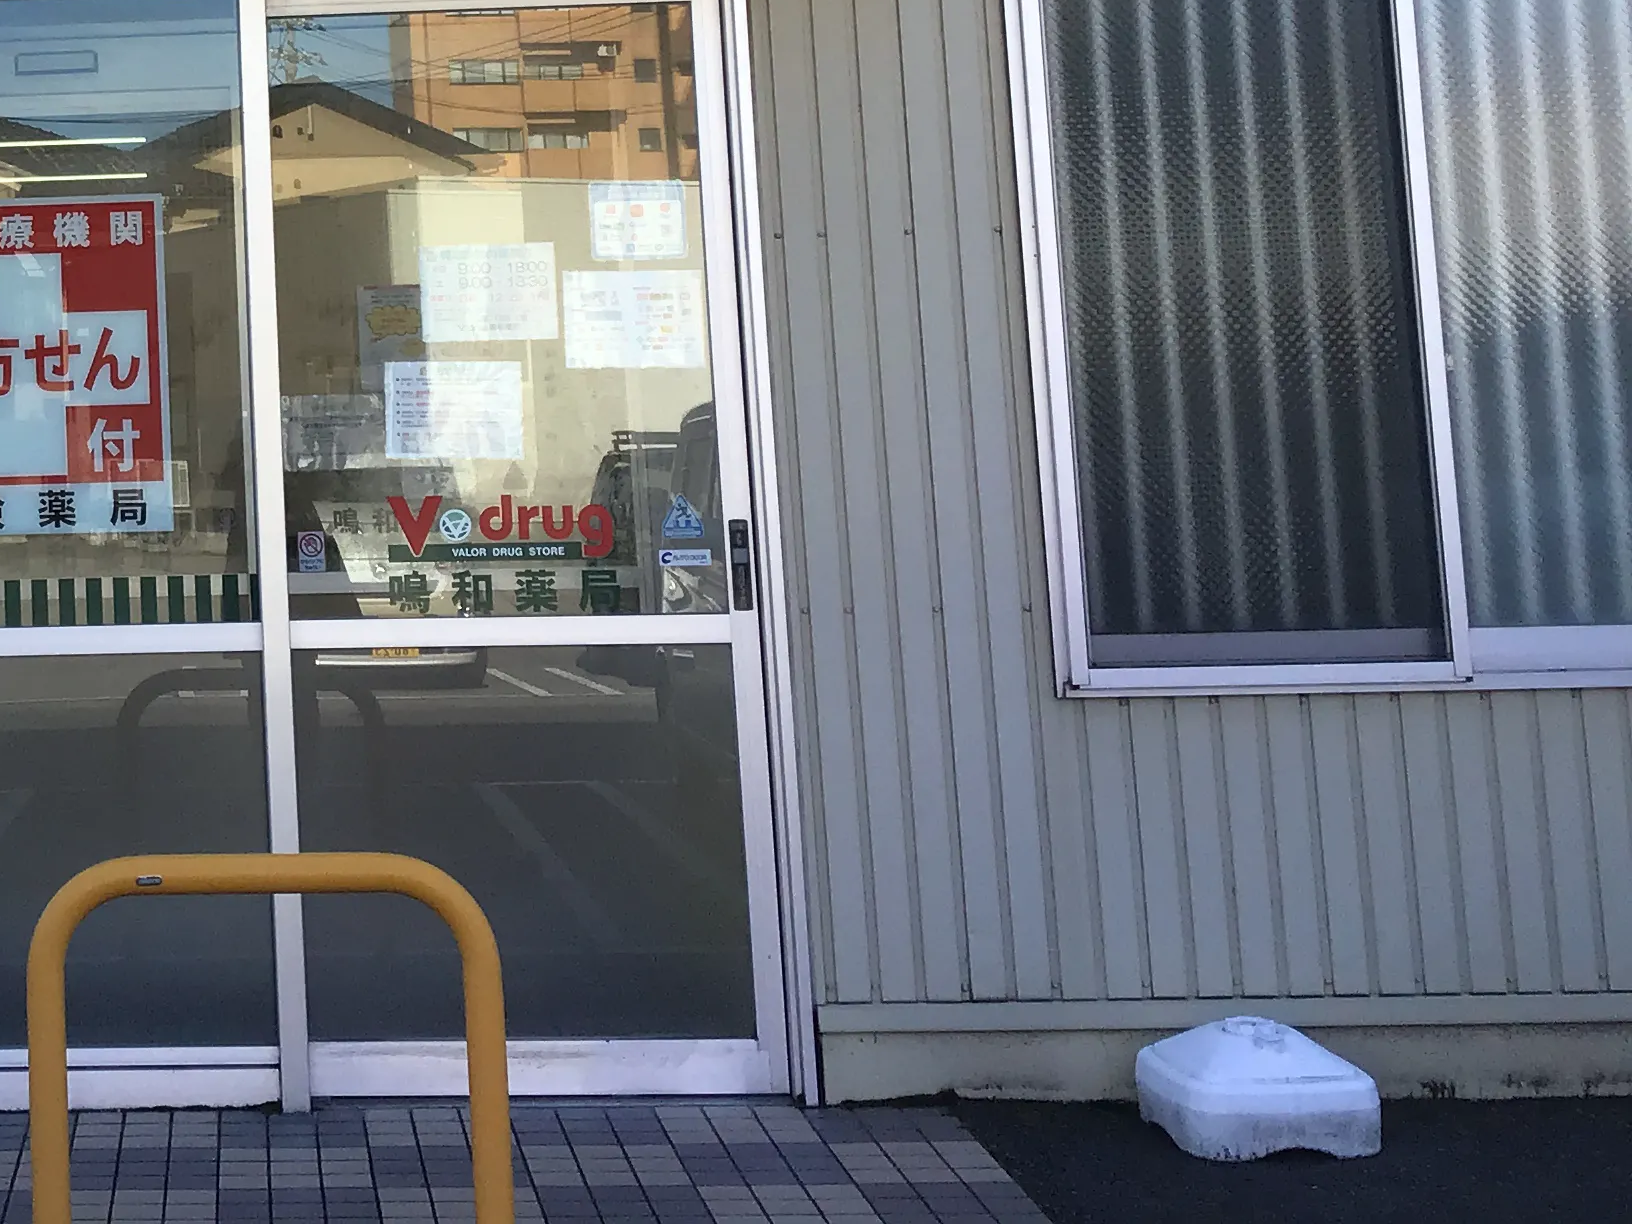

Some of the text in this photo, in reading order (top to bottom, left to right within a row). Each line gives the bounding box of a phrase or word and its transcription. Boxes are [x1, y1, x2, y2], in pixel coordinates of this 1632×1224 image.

[451, 546, 566, 557] VALOR DRUG STORE
[388, 569, 621, 614] 鳴和薬局
